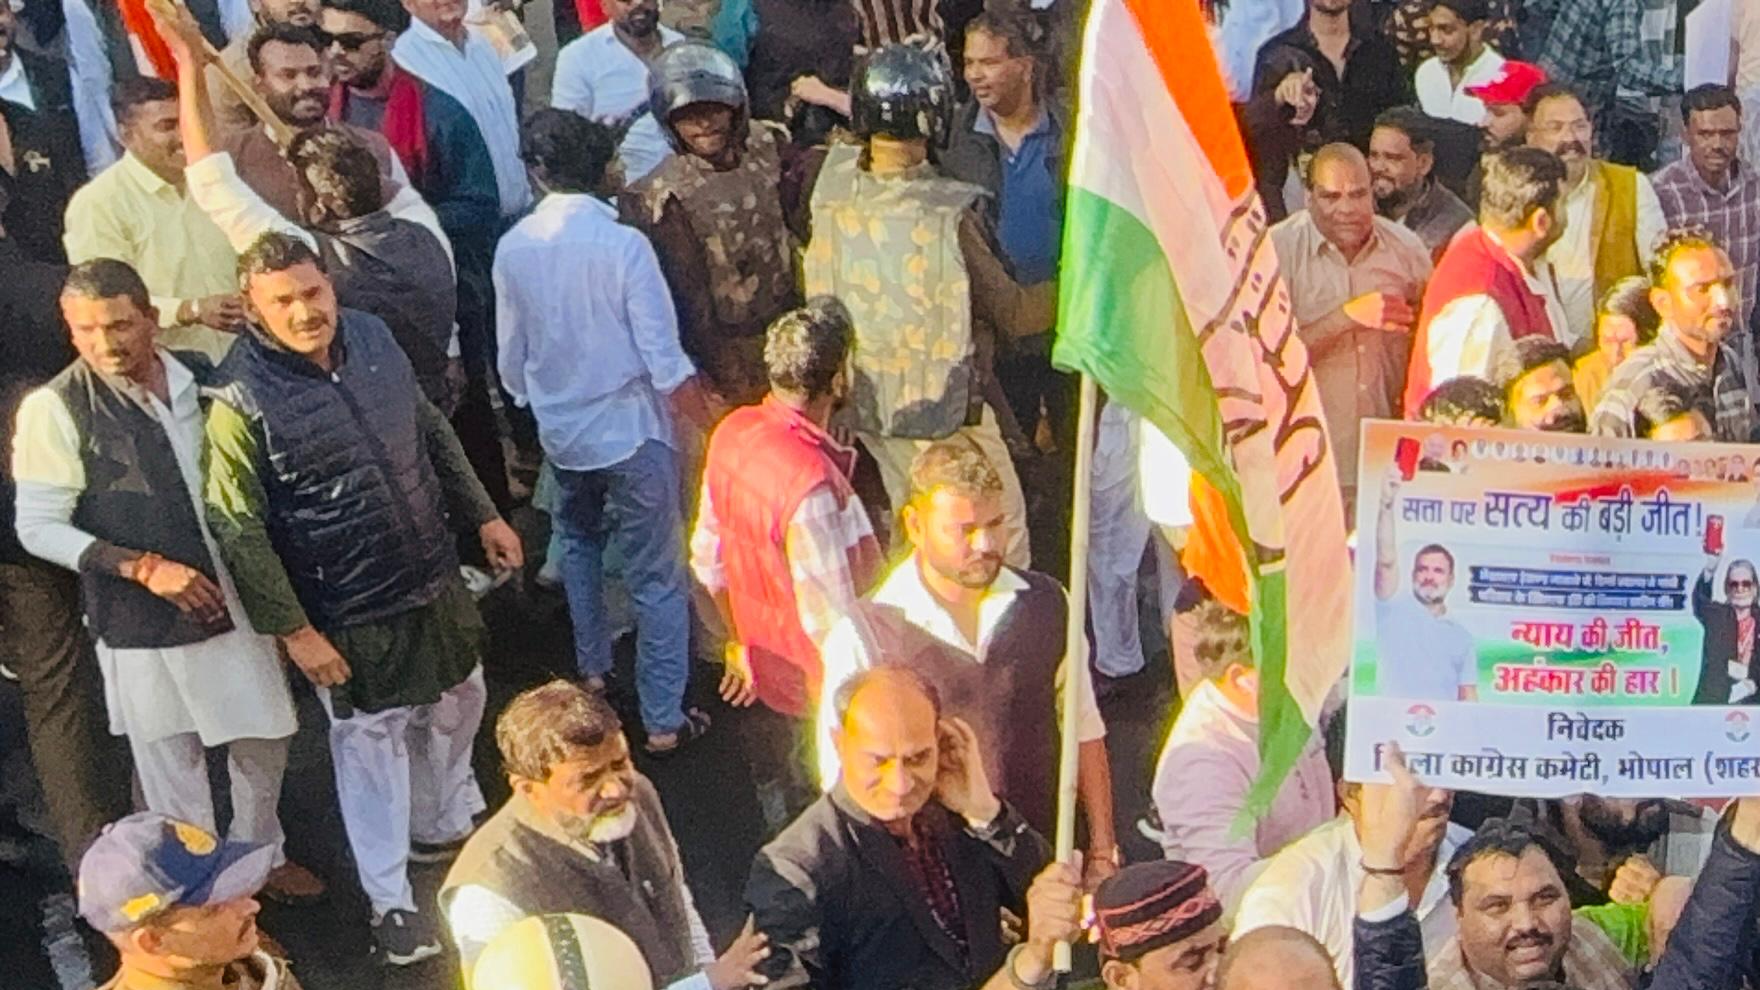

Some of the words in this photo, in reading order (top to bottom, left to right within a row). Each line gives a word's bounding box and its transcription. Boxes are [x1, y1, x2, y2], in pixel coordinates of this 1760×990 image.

[1402, 497, 1442, 522] सत्ता
[1450, 501, 1476, 526] पर
[1484, 491, 1552, 529] सत्य
[1562, 496, 1590, 532] की
[1599, 488, 1632, 541] बड़ी
[1511, 621, 1573, 648] न्याय
[1579, 616, 1608, 649] की
[1591, 662, 1616, 694] की
[1624, 669, 1660, 694] हार
[1547, 712, 1626, 741] निवेदक
[1618, 750, 1695, 780] भोपाल
